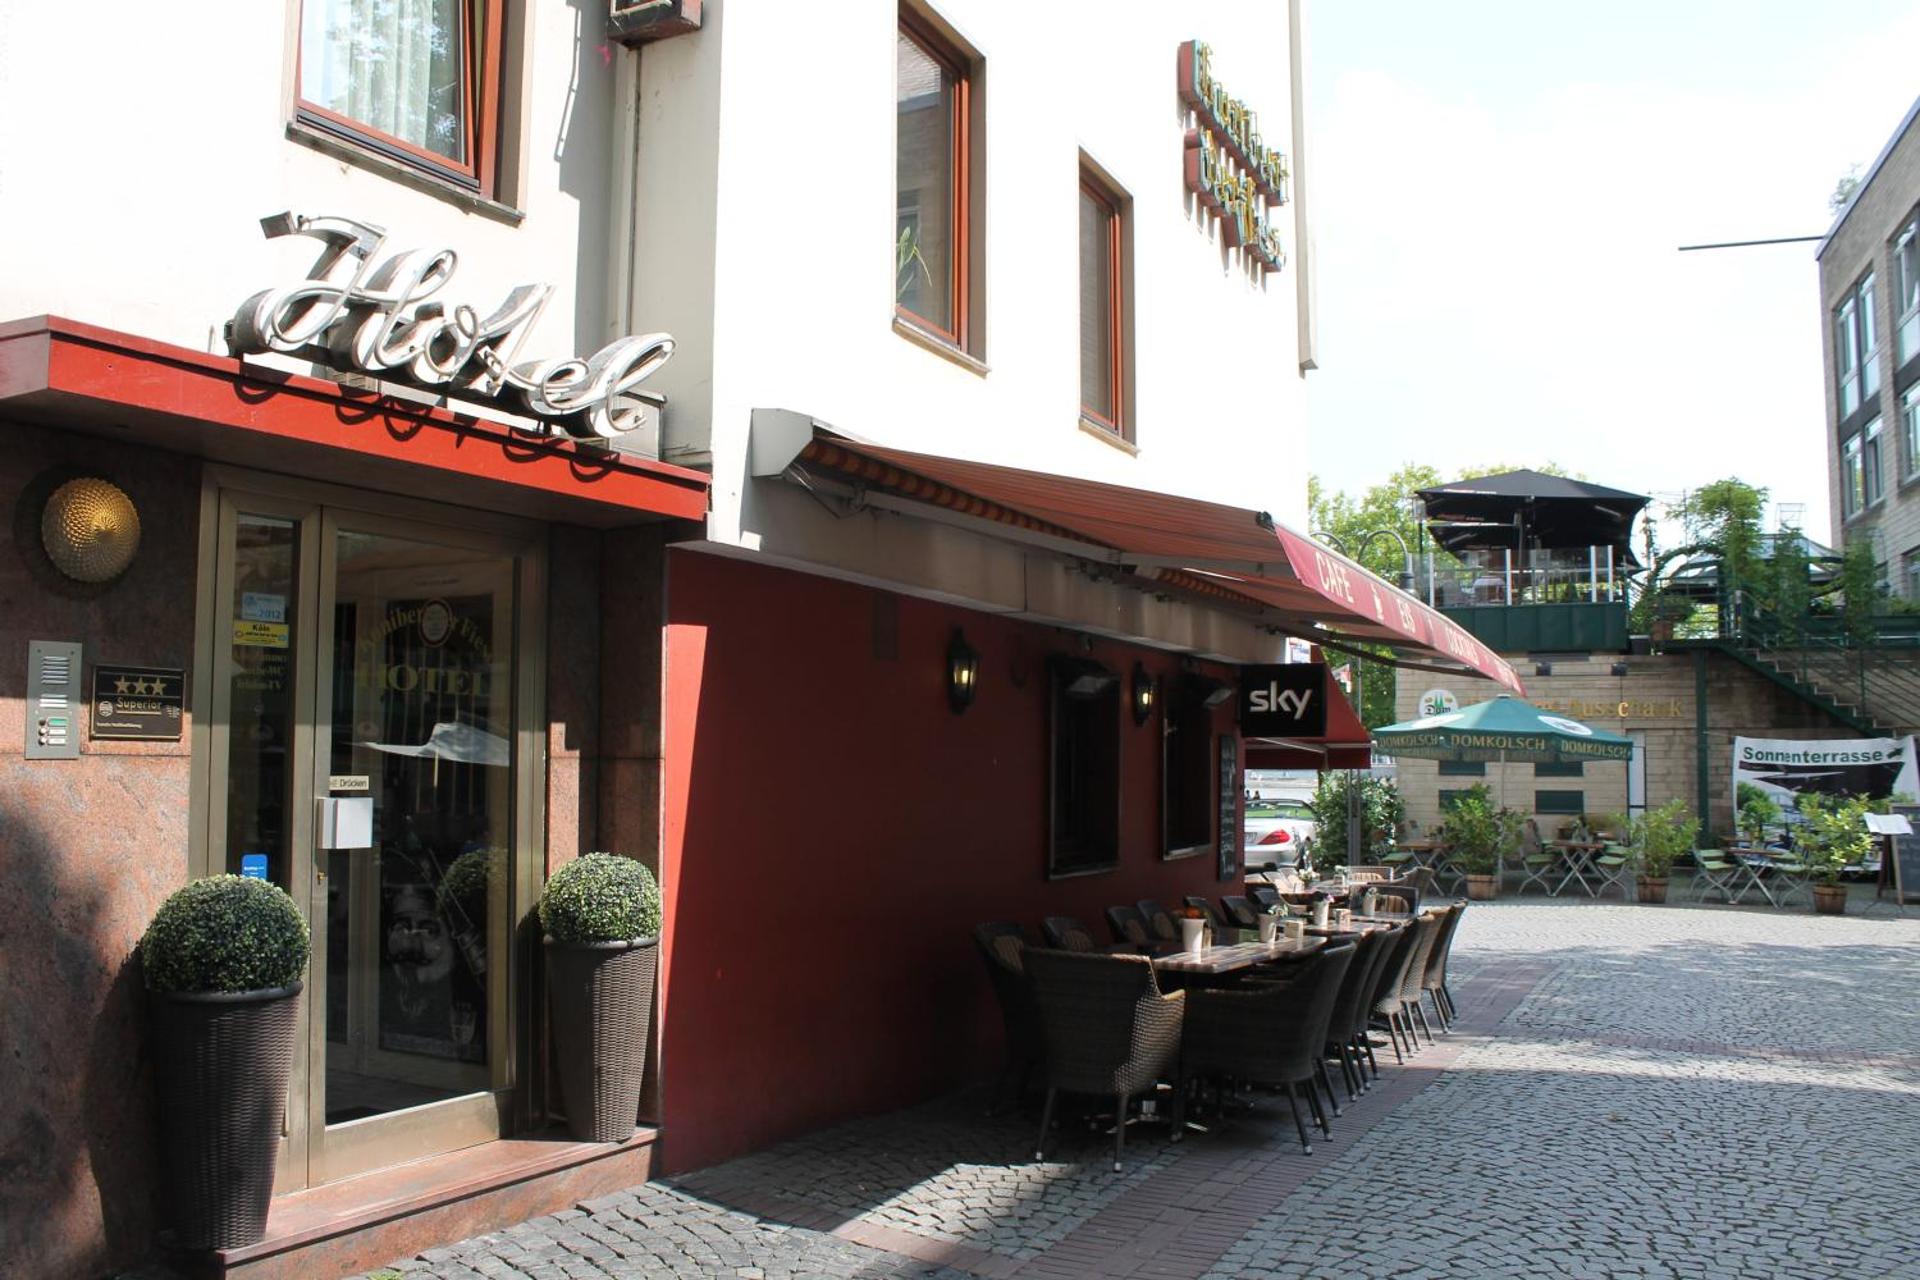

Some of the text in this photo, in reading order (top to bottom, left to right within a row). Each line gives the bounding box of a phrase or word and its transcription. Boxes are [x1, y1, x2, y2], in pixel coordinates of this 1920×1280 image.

[232, 211, 675, 437] Hotel
[116, 697, 162, 712] Superior
[1249, 680, 1313, 720] sky
[1743, 746, 1884, 764] Sonnenterrasse
